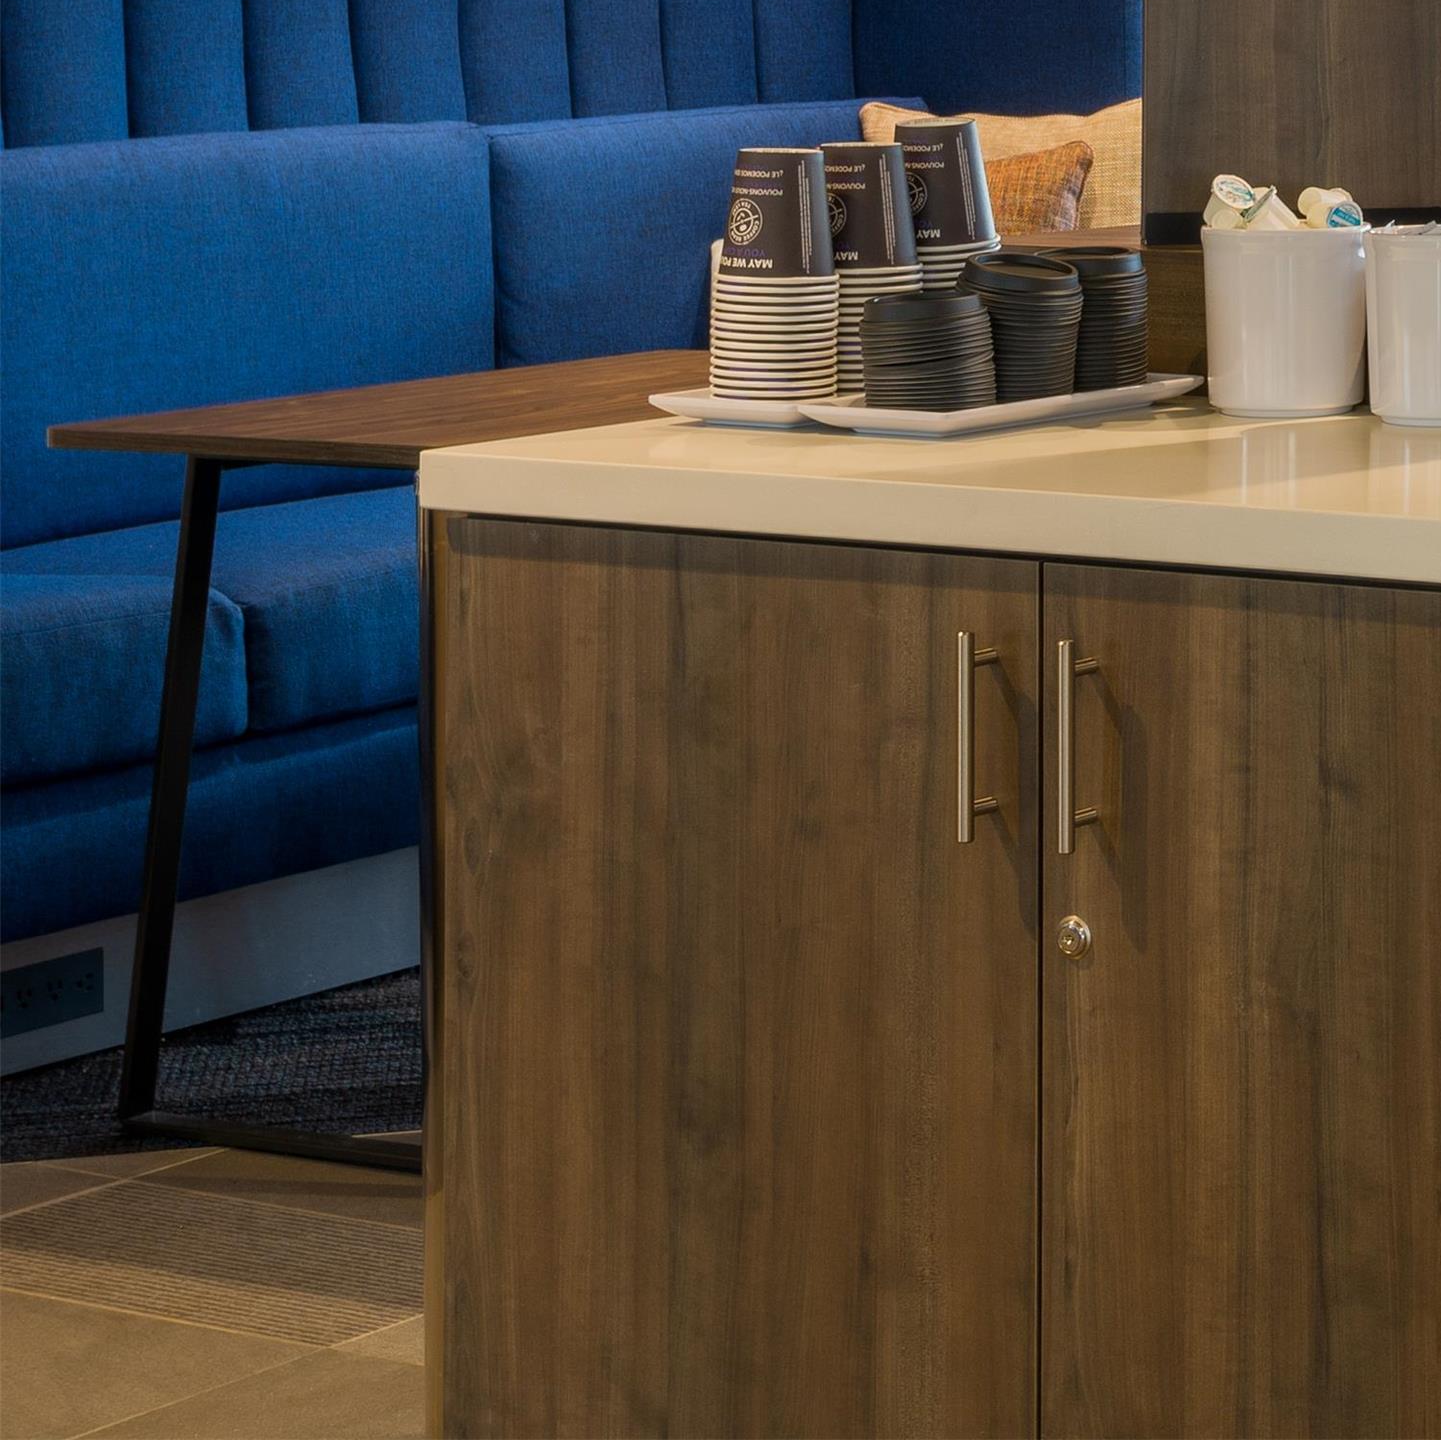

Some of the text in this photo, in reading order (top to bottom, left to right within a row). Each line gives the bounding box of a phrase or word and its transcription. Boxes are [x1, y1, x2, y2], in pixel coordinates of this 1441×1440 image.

[916, 228, 941, 239] MAY
[834, 251, 859, 261] MAY
[732, 257, 747, 268] WE
[748, 258, 773, 269] MAY
